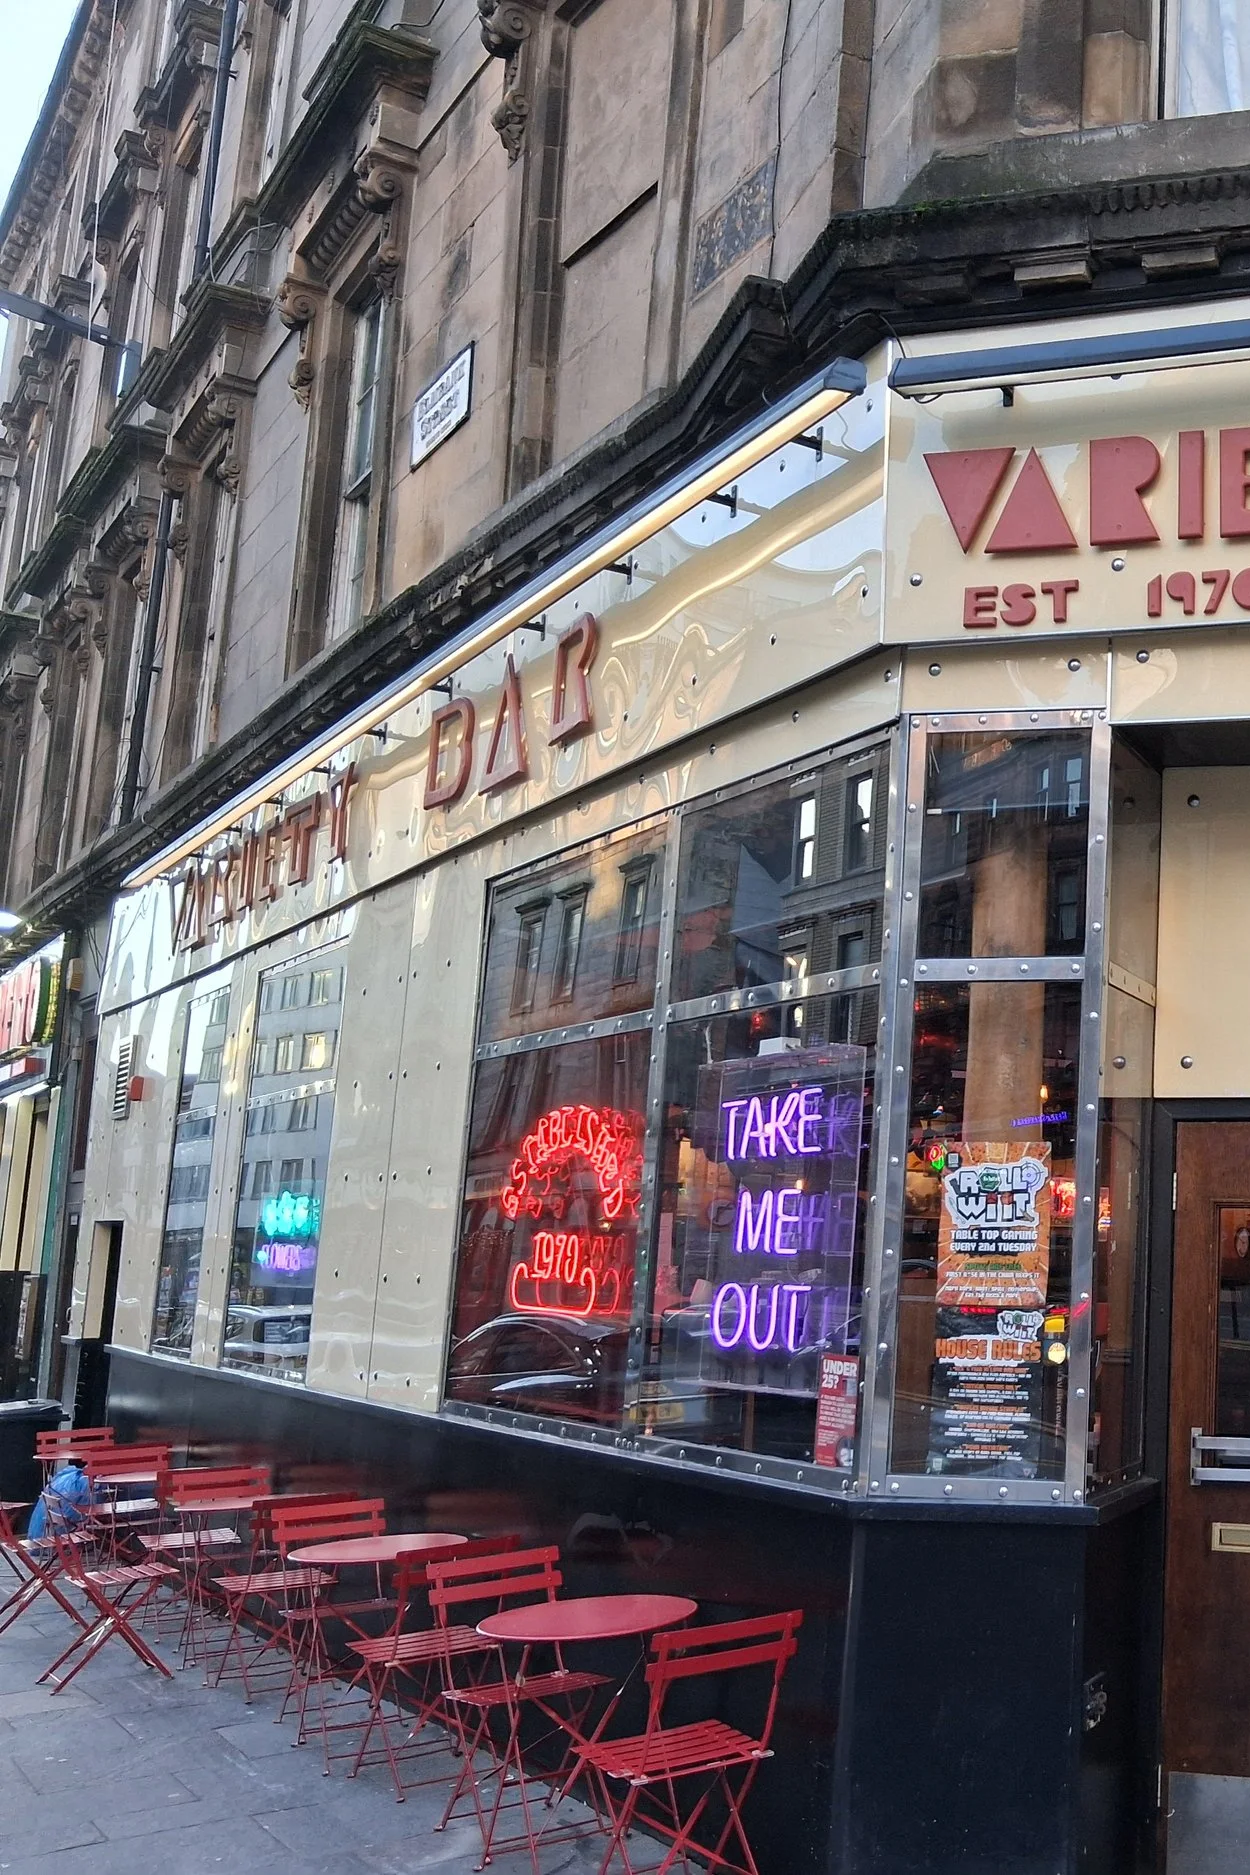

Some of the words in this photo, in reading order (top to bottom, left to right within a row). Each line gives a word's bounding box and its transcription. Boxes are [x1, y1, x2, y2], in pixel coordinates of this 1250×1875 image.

[963, 579, 1080, 629] EST
[168, 761, 359, 955] VARIETY
[423, 611, 598, 810] BAR
[722, 1086, 823, 1161] TAKE
[735, 1188, 801, 1255] ME
[950, 1230, 979, 1241] TABLE
[981, 1230, 1000, 1241] TOP
[1001, 1230, 1038, 1241] GAMING
[531, 1232, 579, 1283] 1970
[950, 1243, 977, 1253] EVERY
[997, 1243, 1038, 1252] TUESDAY
[712, 1282, 812, 1351] OUT
[823, 1359, 858, 1377] UNDER
[935, 1338, 988, 1360] HOUSE
[991, 1340, 1042, 1362] RULES
[821, 1373, 840, 1390] 25?
